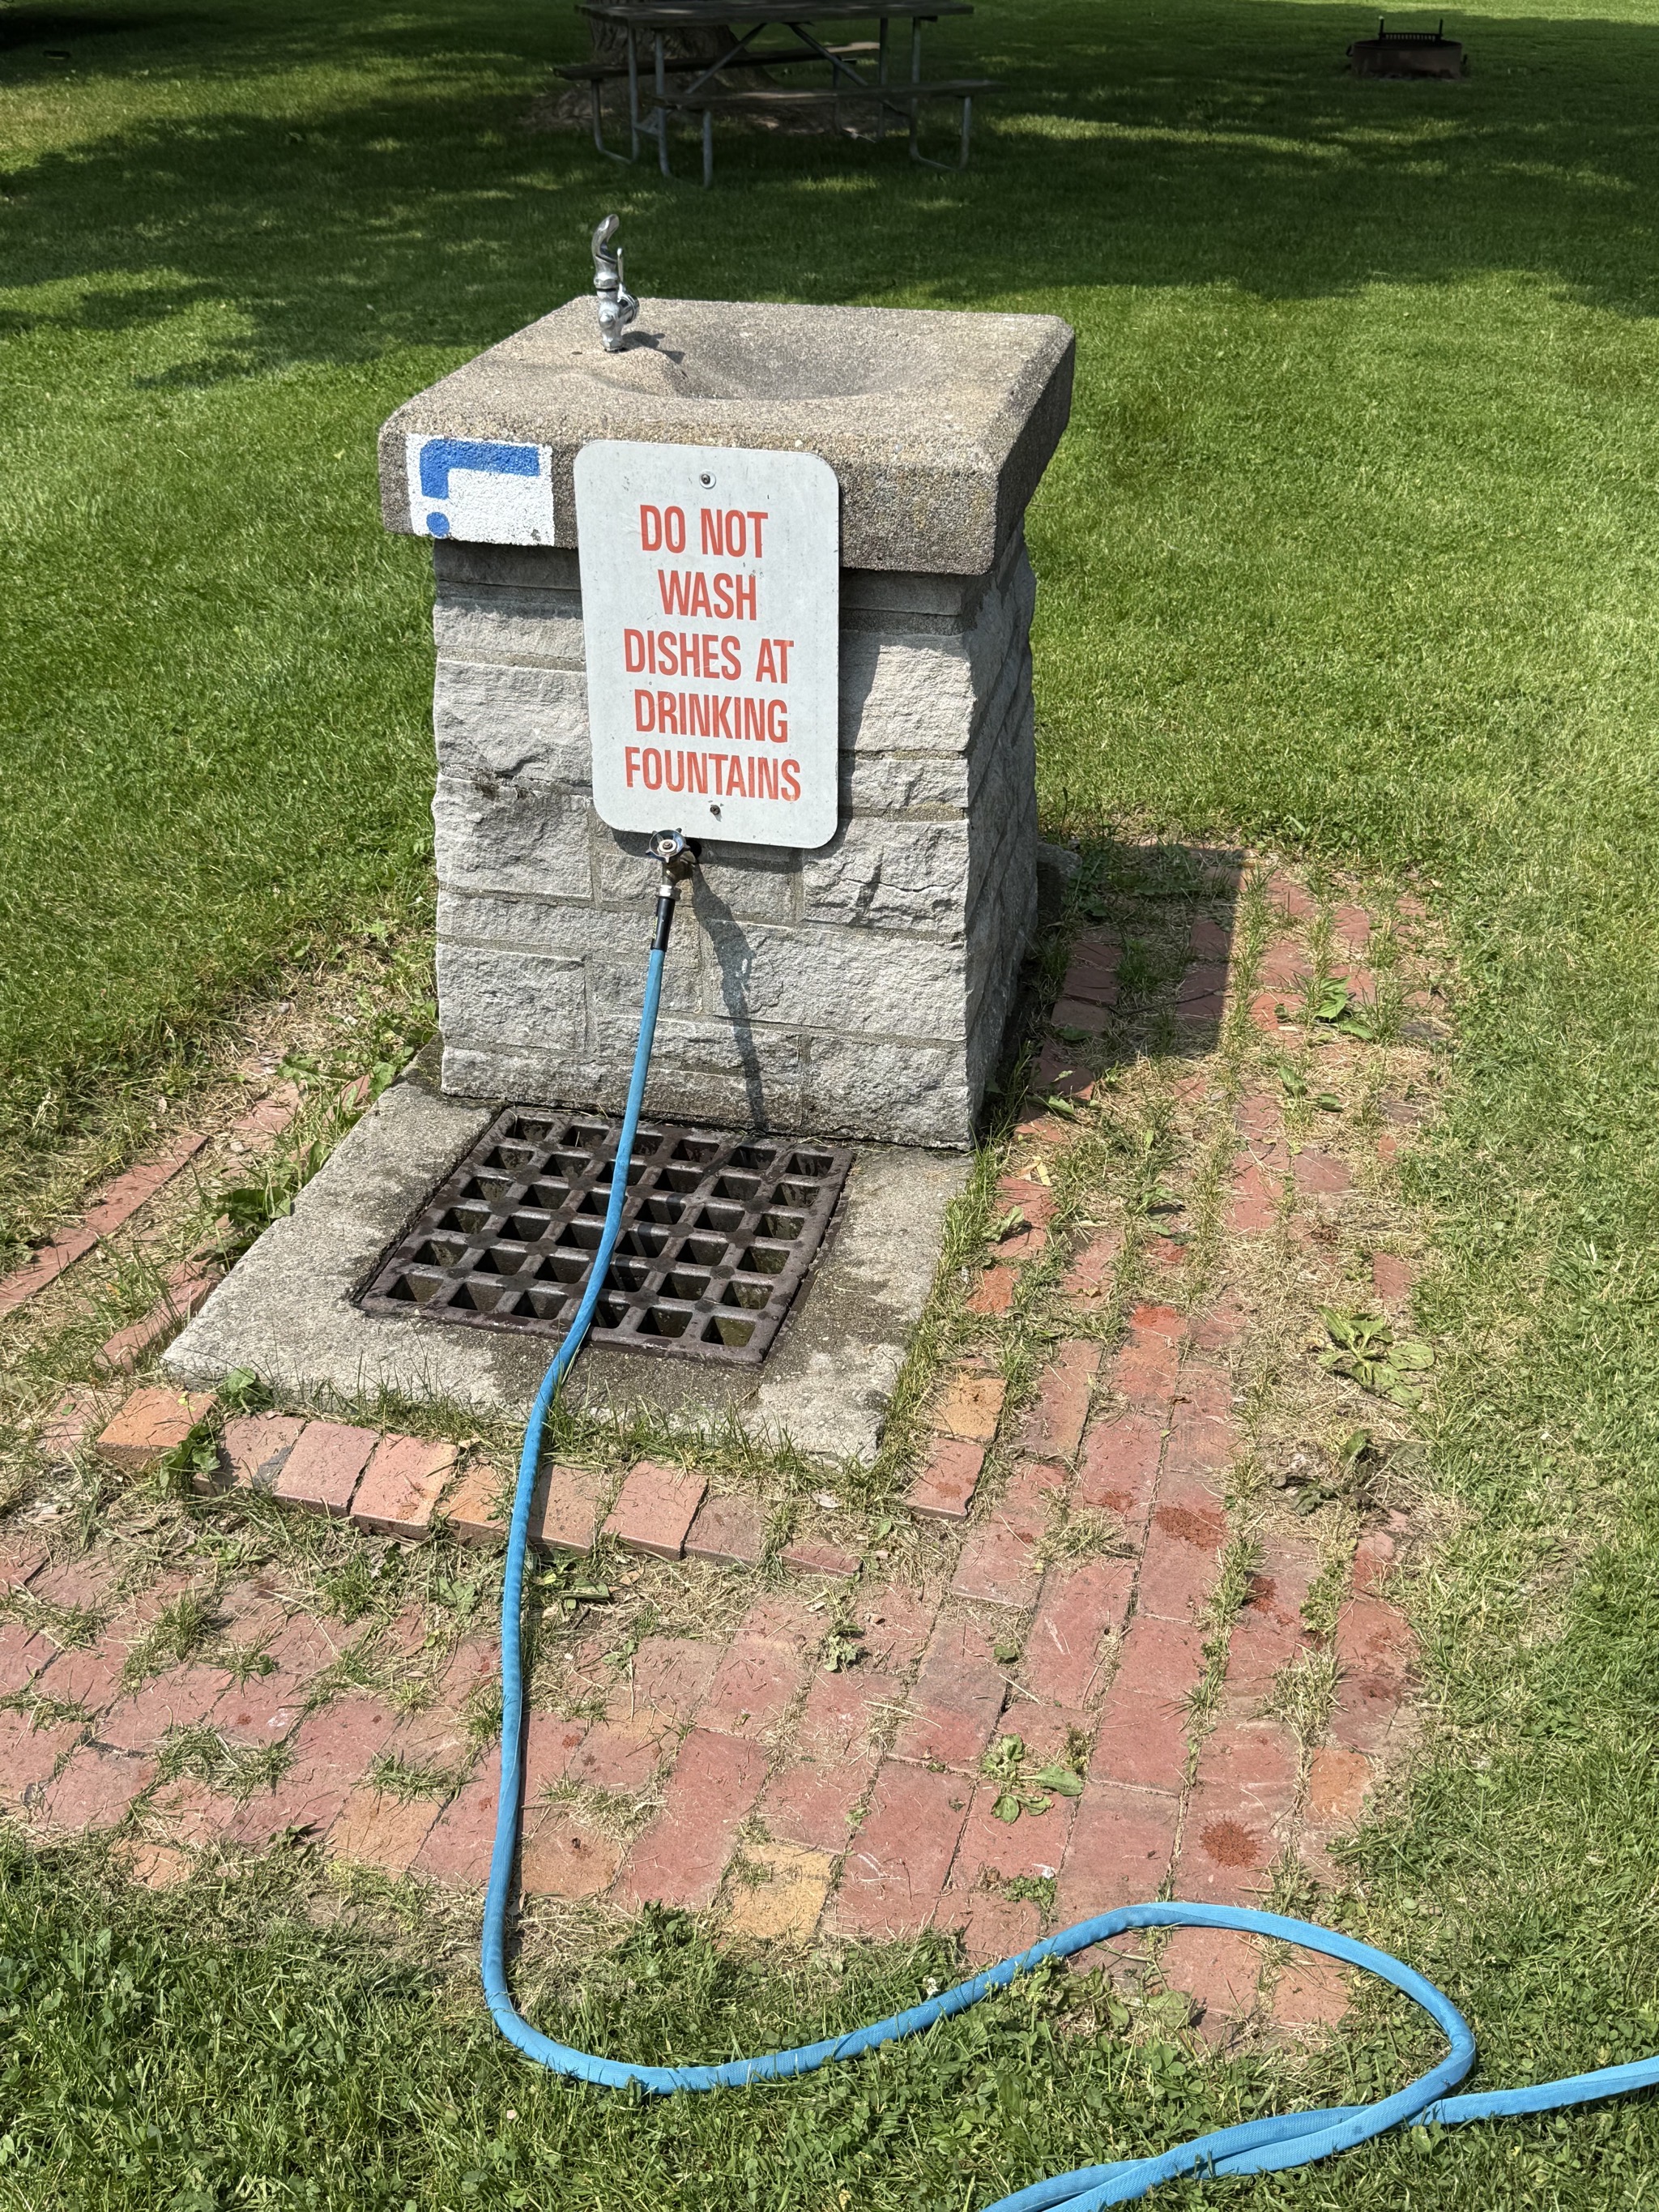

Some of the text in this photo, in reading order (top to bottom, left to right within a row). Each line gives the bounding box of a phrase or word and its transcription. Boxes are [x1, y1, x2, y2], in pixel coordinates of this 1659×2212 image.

[640, 505, 769, 559] DO NOT
[658, 570, 757, 621] WASH
[624, 629, 795, 685] DISHES AT
[635, 690, 789, 744] DRINKING
[625, 747, 802, 802] FOUNTAINS
